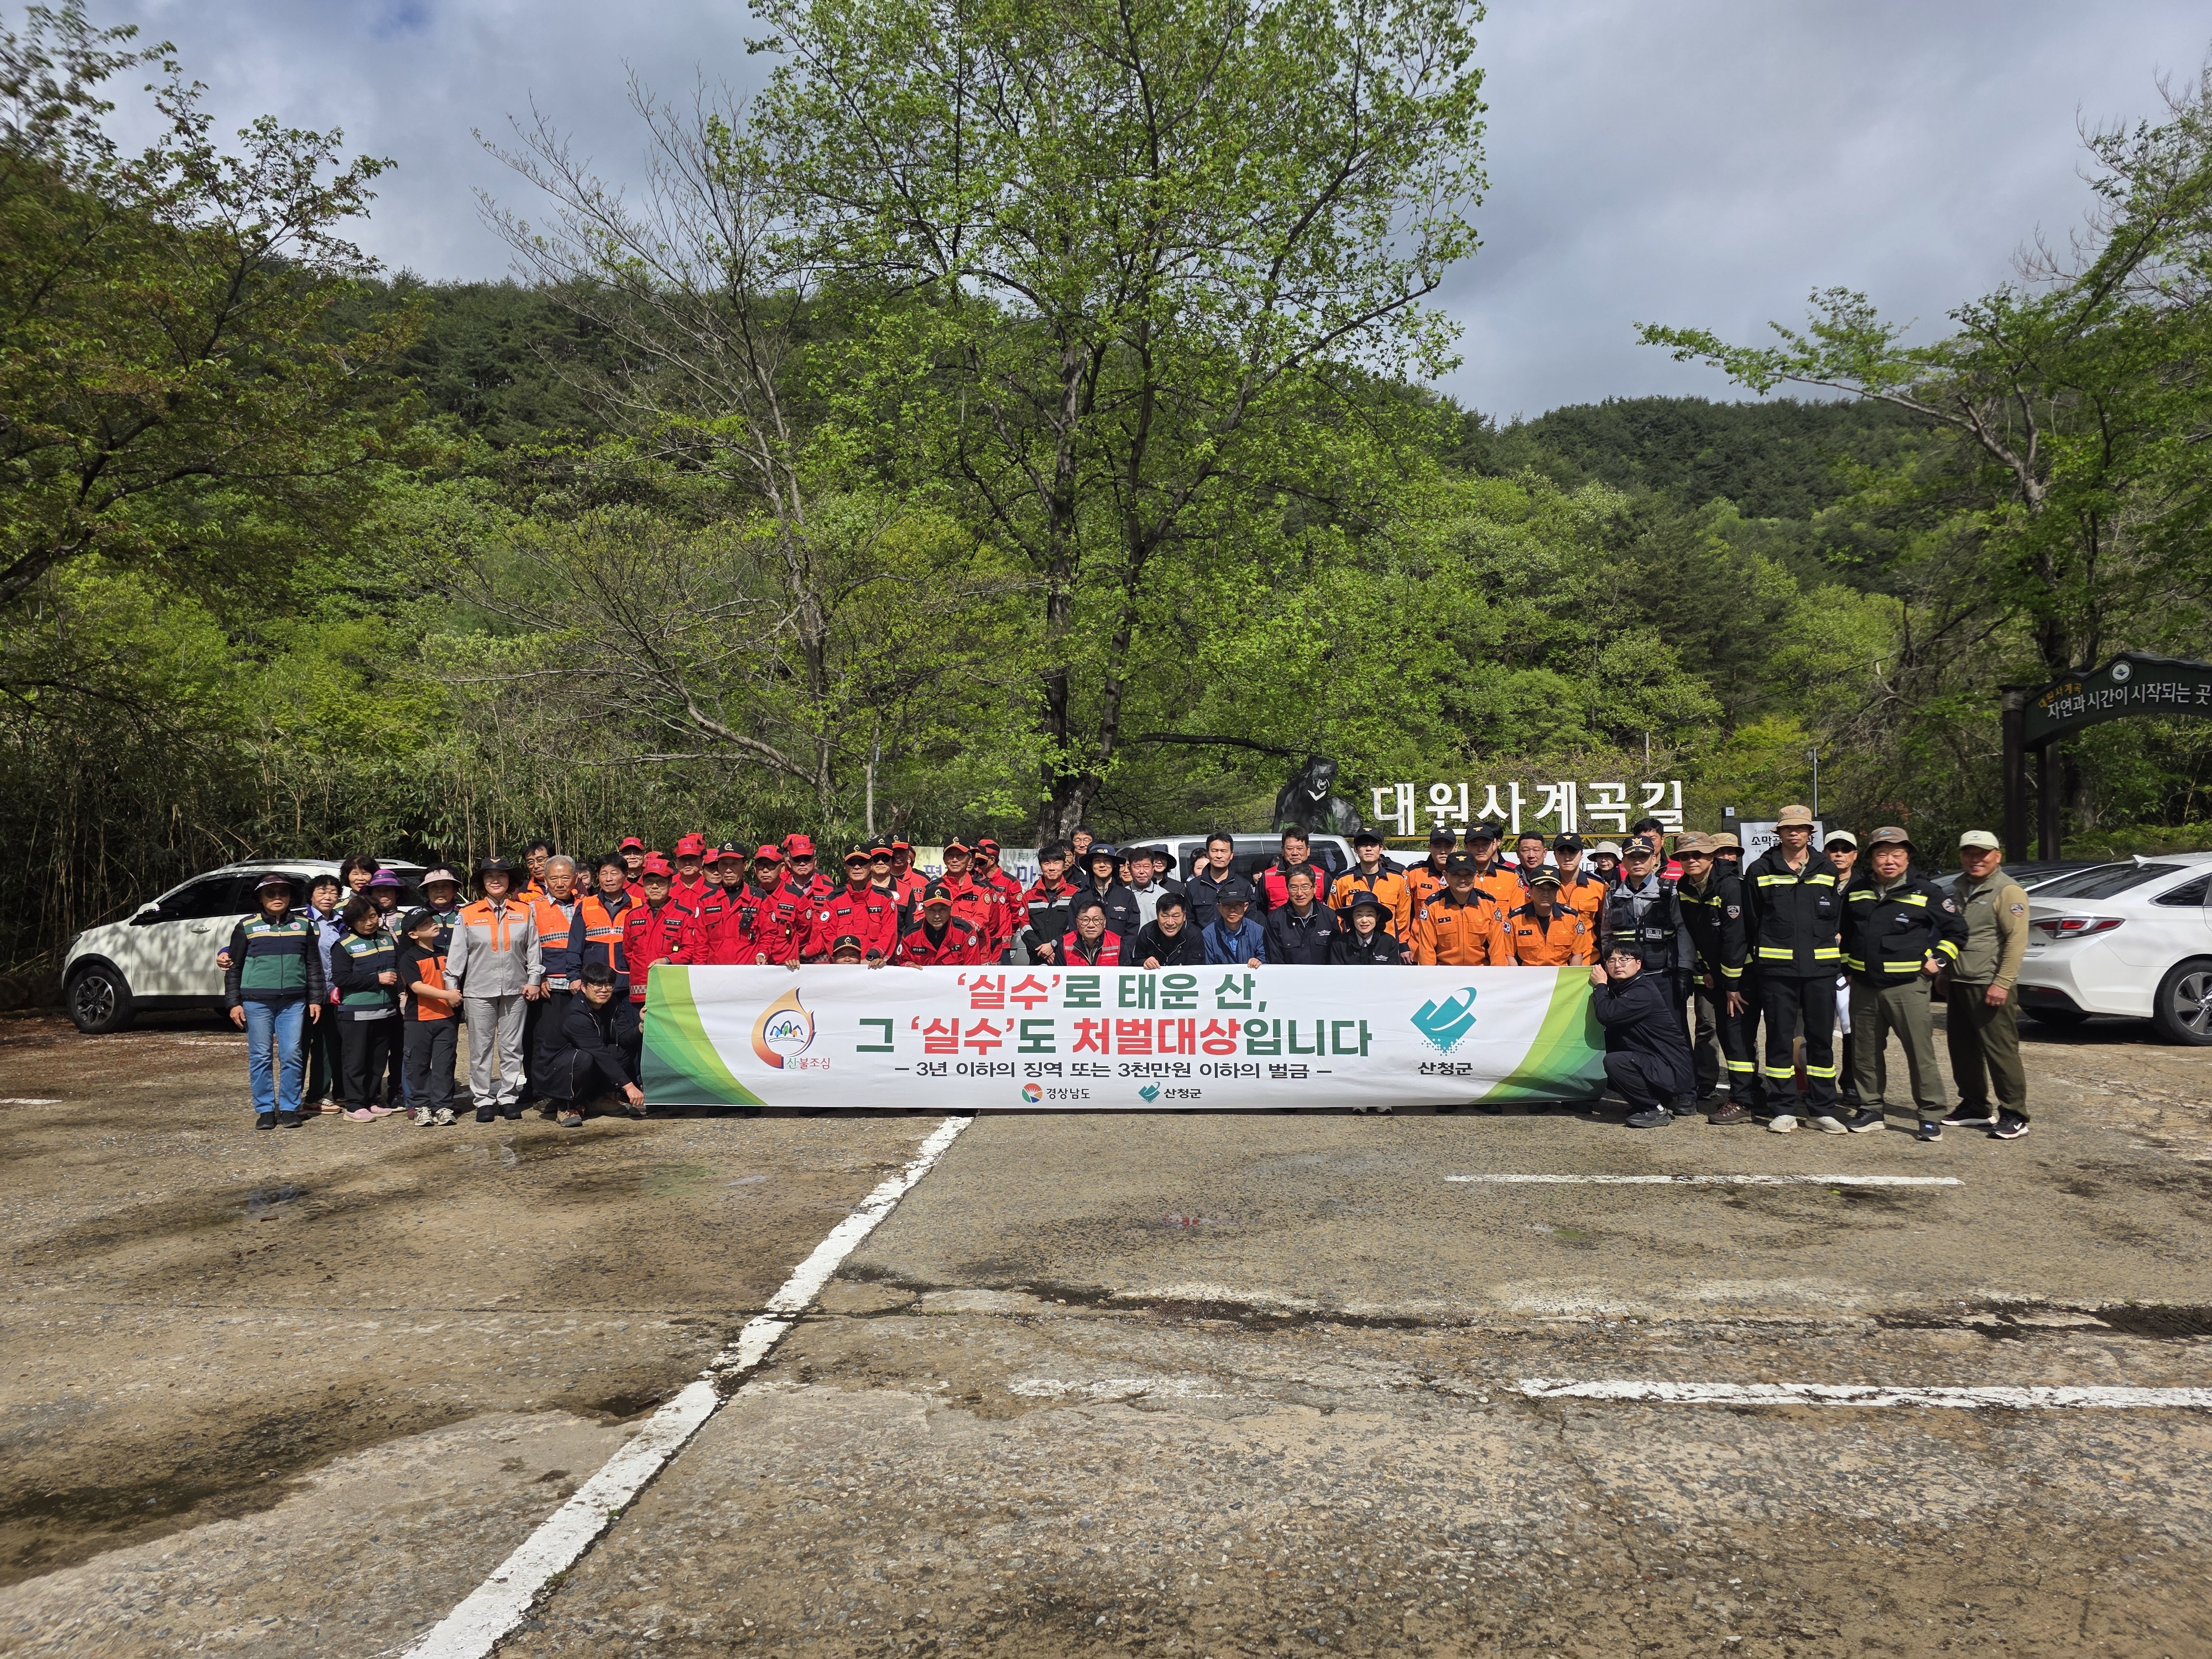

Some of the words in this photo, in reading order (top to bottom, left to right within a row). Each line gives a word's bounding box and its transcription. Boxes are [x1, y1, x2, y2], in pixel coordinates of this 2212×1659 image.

[2038, 683, 2082, 708] 대원사계곡
[2131, 682, 2191, 703] 시작되는
[2195, 684, 2211, 705] 곳
[1370, 780, 1684, 836] 대원사계곡길
[957, 973, 1102, 1010] ‘실수’로
[1118, 973, 1199, 1010] 태운
[1215, 973, 1267, 1012] 산,
[856, 1018, 894, 1052] 그
[911, 1015, 1056, 1056] ‘실수’도
[1072, 1018, 1373, 1057] 처벌대상입니다
[786, 1057, 831, 1070] 산불조심
[916, 1061, 947, 1077] 3년
[956, 1061, 1015, 1078] 이하의
[1023, 1062, 1062, 1078] 징역
[1070, 1062, 1111, 1078] 또는
[1118, 1062, 1191, 1078] 3천만원
[1199, 1062, 1260, 1079] 이하의
[1269, 1063, 1310, 1079] 벌금
[1417, 1062, 1473, 1076] 산청군
[1046, 1088, 1091, 1099] 경상남도
[1164, 1088, 1202, 1099] 산청군
